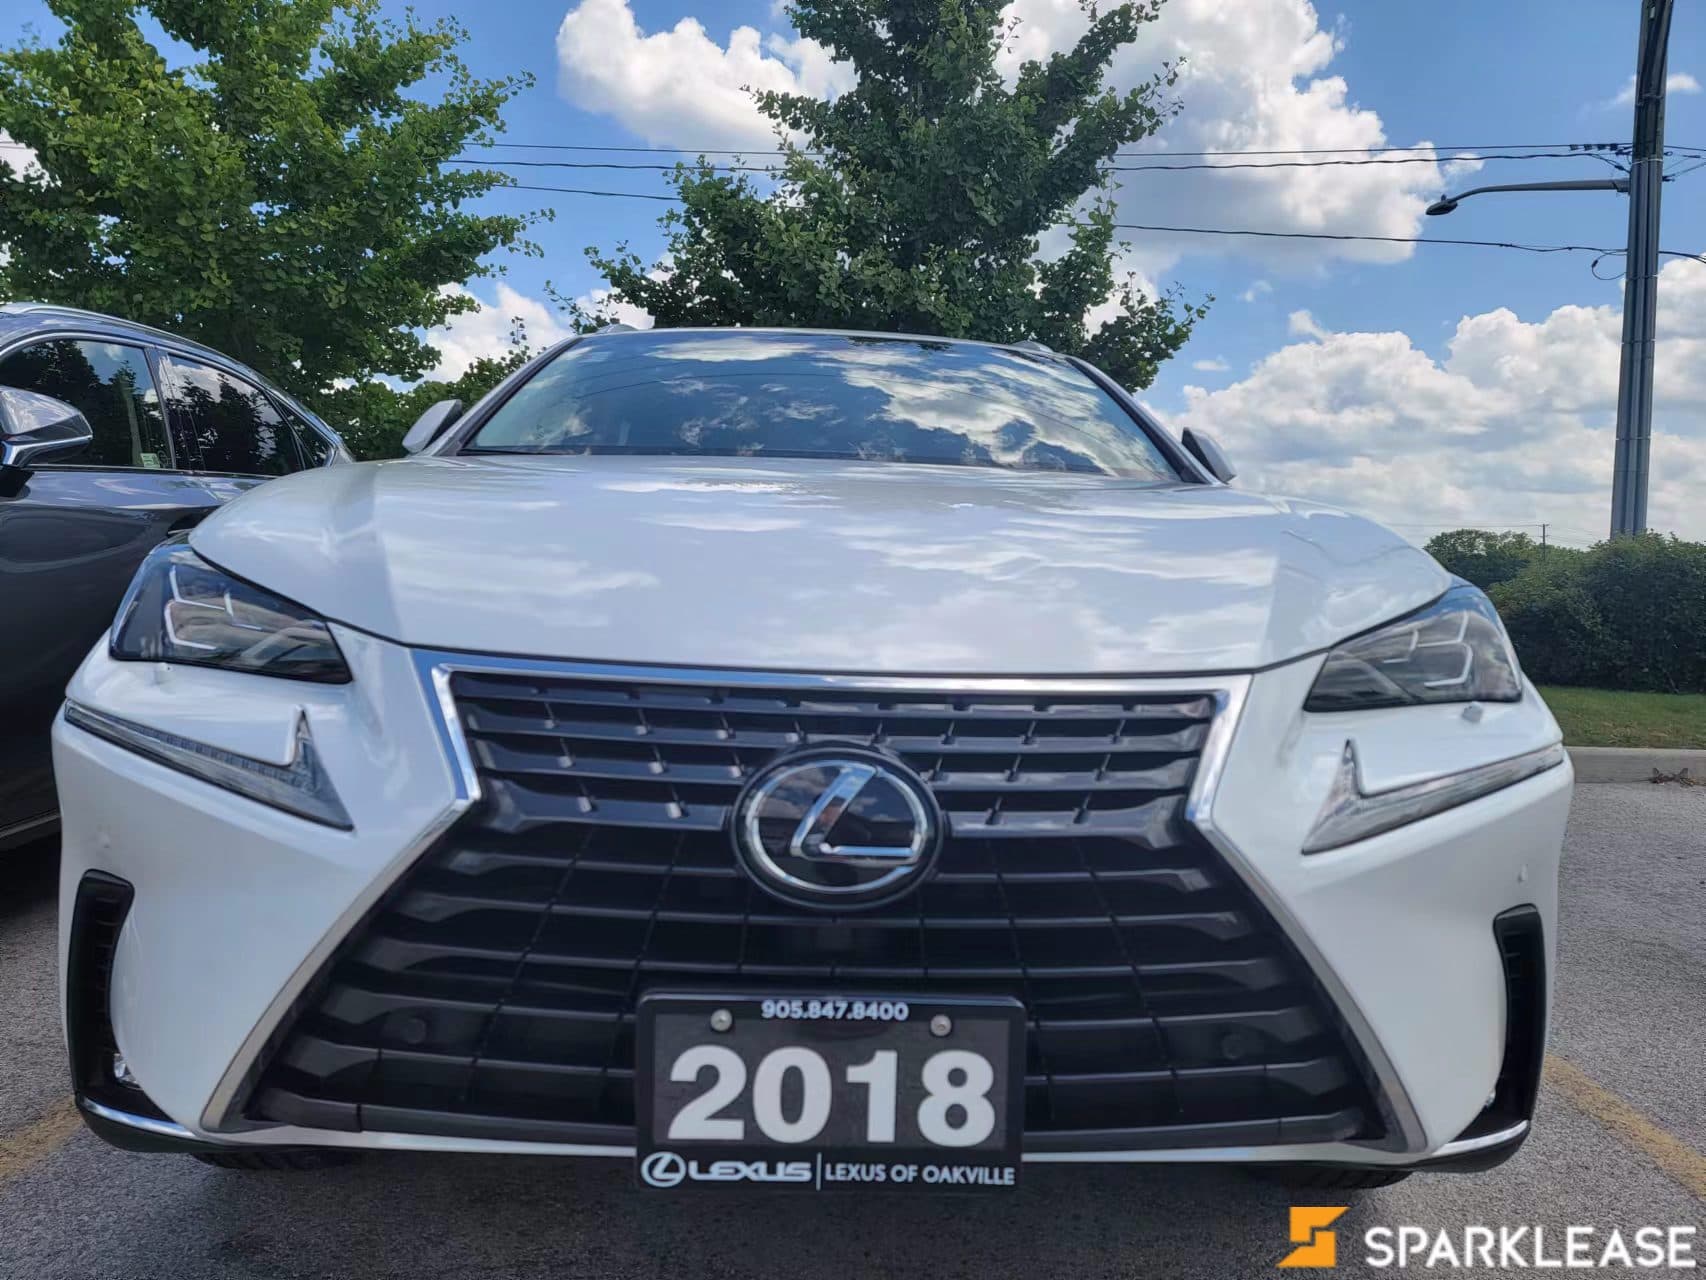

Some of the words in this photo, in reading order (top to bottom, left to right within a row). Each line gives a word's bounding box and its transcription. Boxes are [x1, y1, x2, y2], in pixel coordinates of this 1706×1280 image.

[761, 999, 909, 1021] 905.847.8400
[668, 1045, 995, 1147] 2018
[688, 1160, 812, 1181] LEXUS
[825, 1163, 886, 1182] LEXUS
[891, 1164, 918, 1182] OF
[922, 1165, 1015, 1186] OAKVILLE
